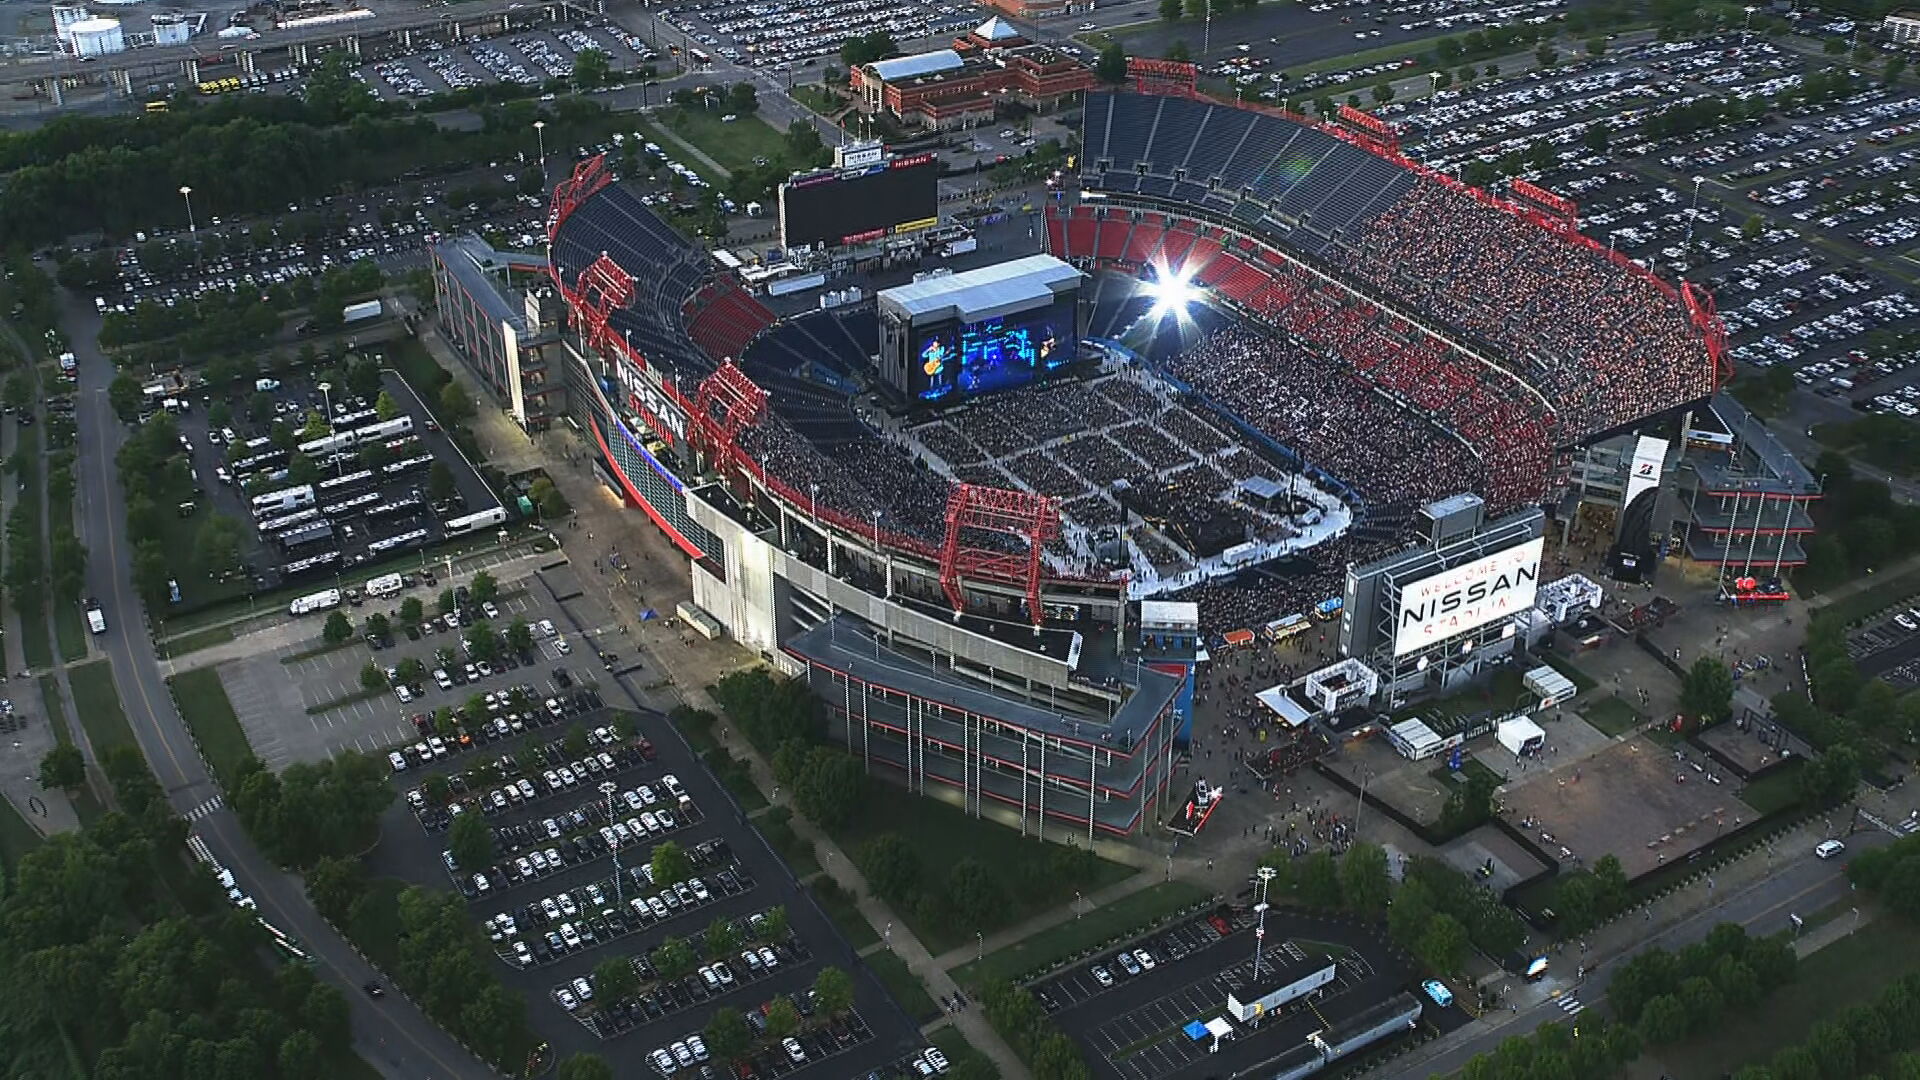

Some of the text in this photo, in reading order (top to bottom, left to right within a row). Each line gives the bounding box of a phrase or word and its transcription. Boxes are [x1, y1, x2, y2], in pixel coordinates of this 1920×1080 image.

[895, 156, 927, 168] NISSAN
[616, 358, 684, 440] NISSAN
[628, 392, 675, 448] STADIUM
[1402, 561, 1537, 628] NISSAN
[1423, 596, 1512, 635] STADIM
